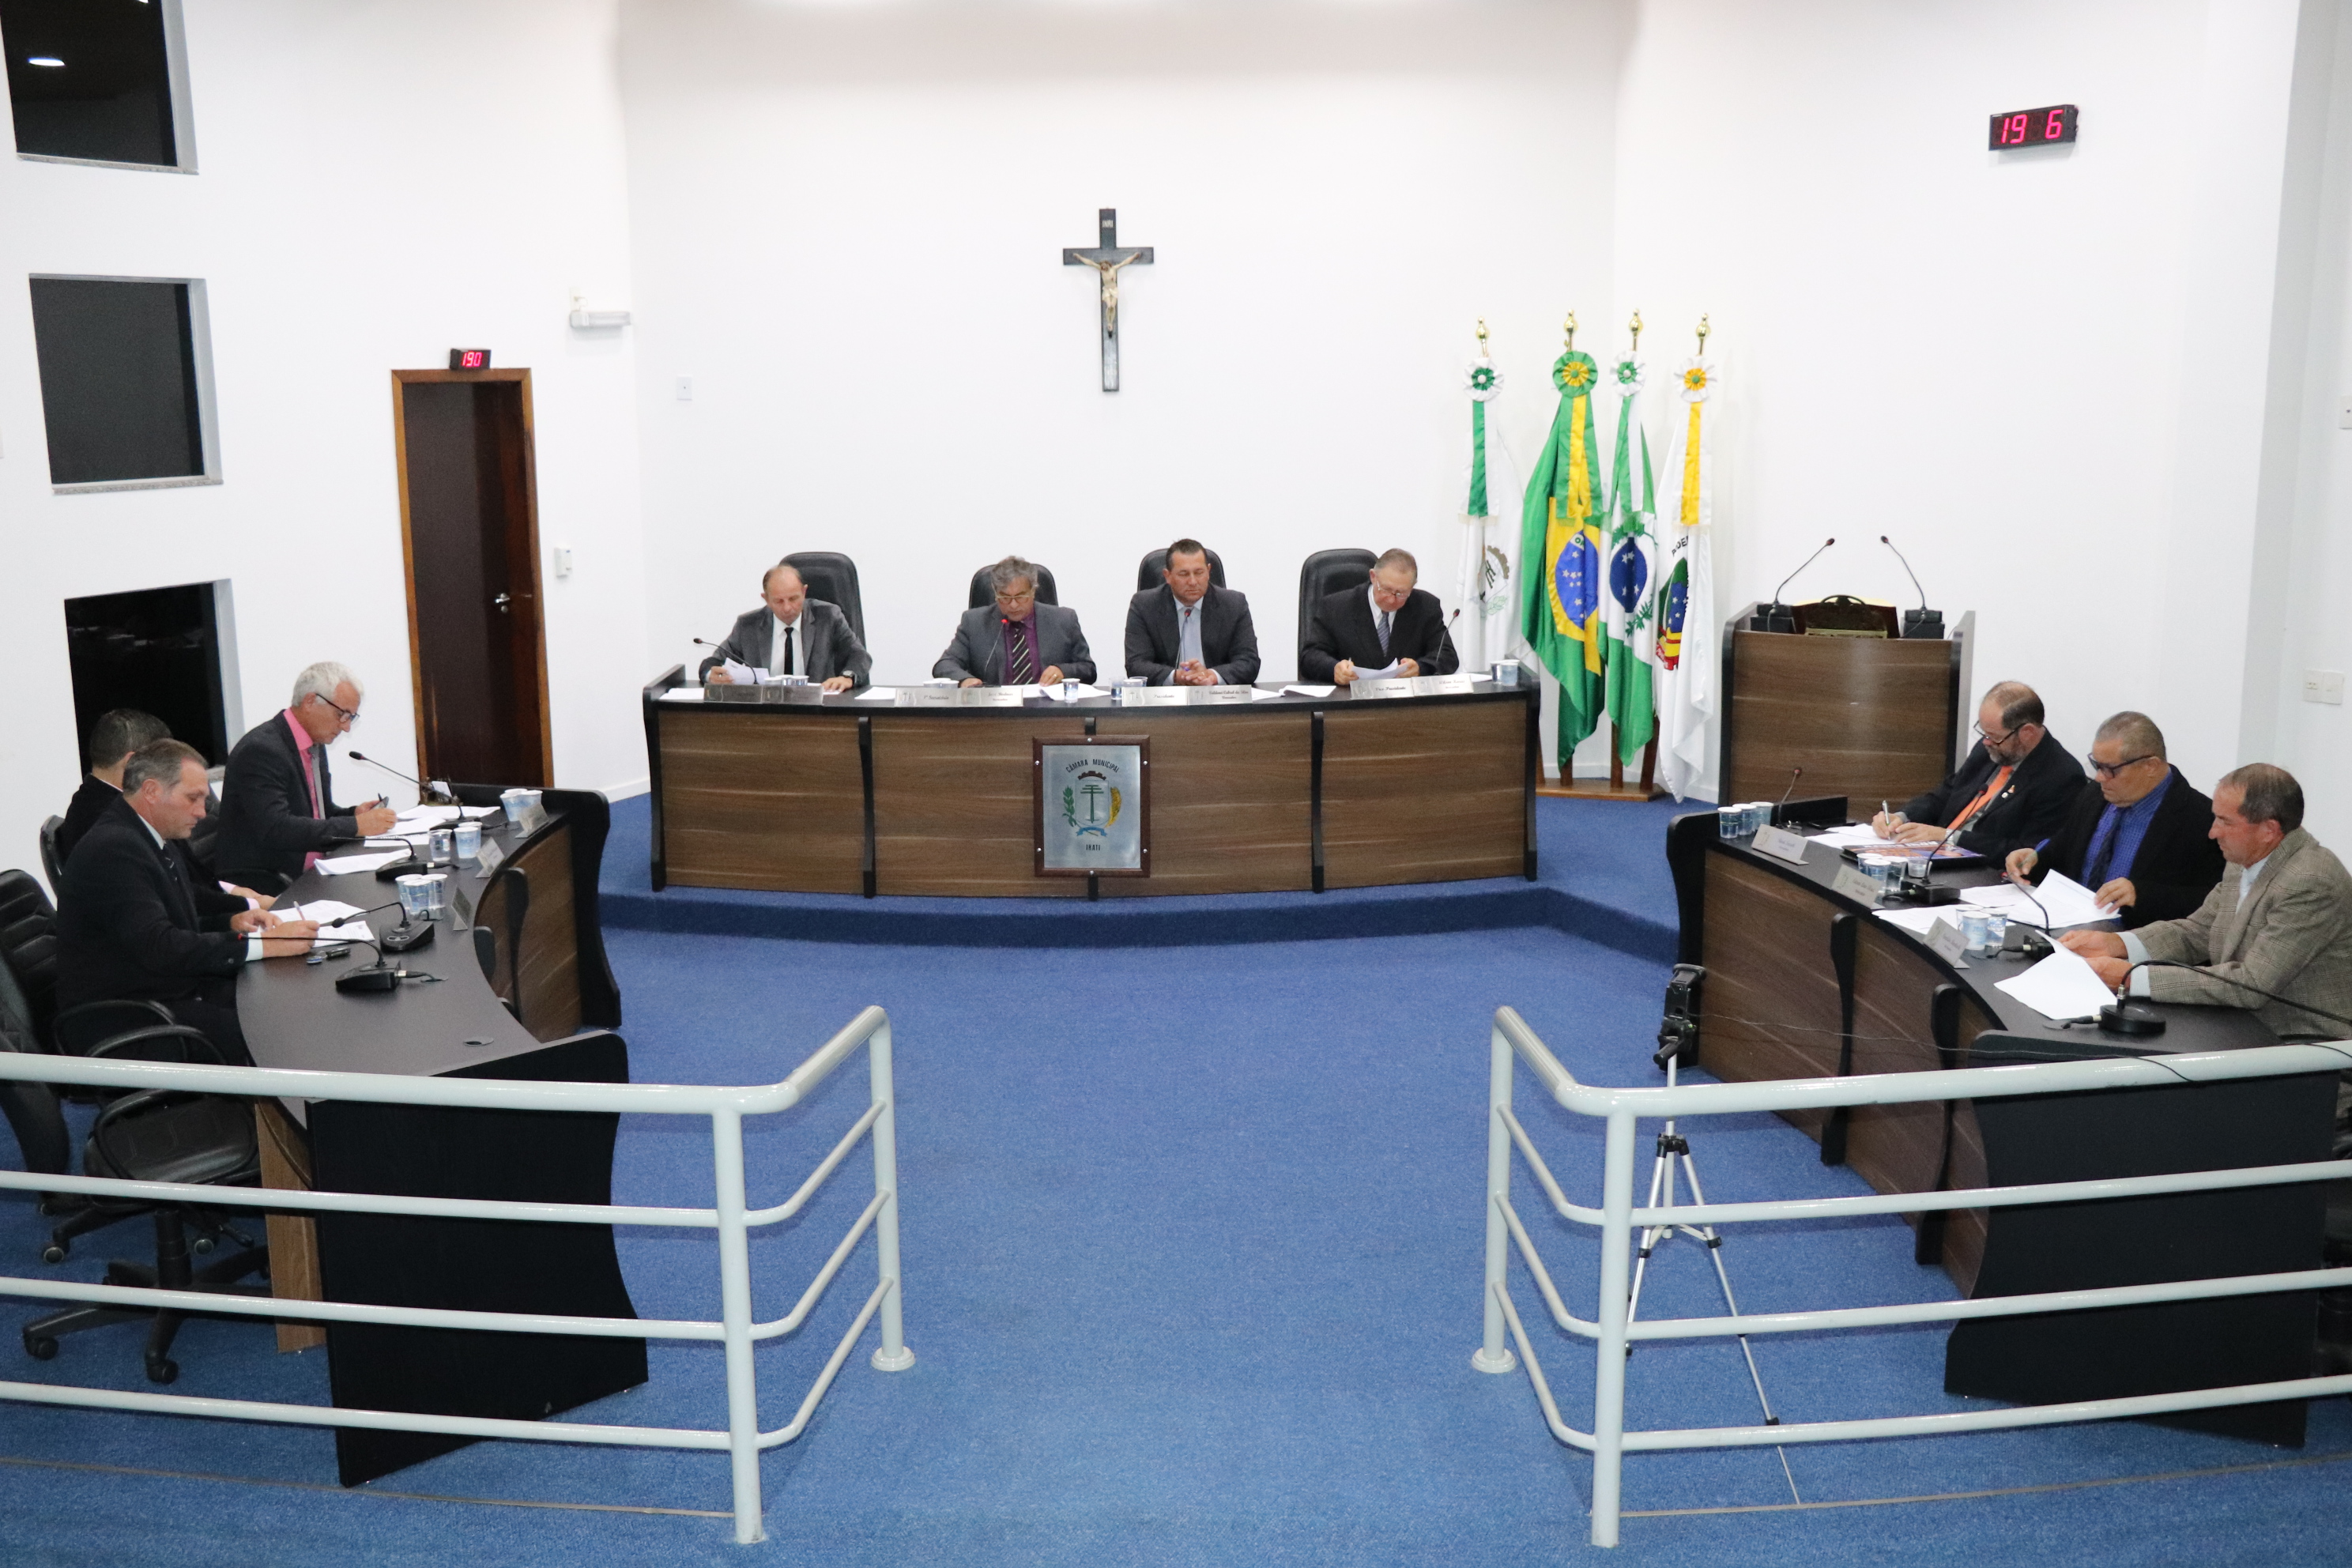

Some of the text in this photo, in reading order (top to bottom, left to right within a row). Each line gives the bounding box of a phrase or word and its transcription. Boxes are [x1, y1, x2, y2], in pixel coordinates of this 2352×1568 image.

[2001, 109, 2064, 144] 19 6
[1102, 220, 1114, 228] INRI
[462, 351, 483, 368] 190
